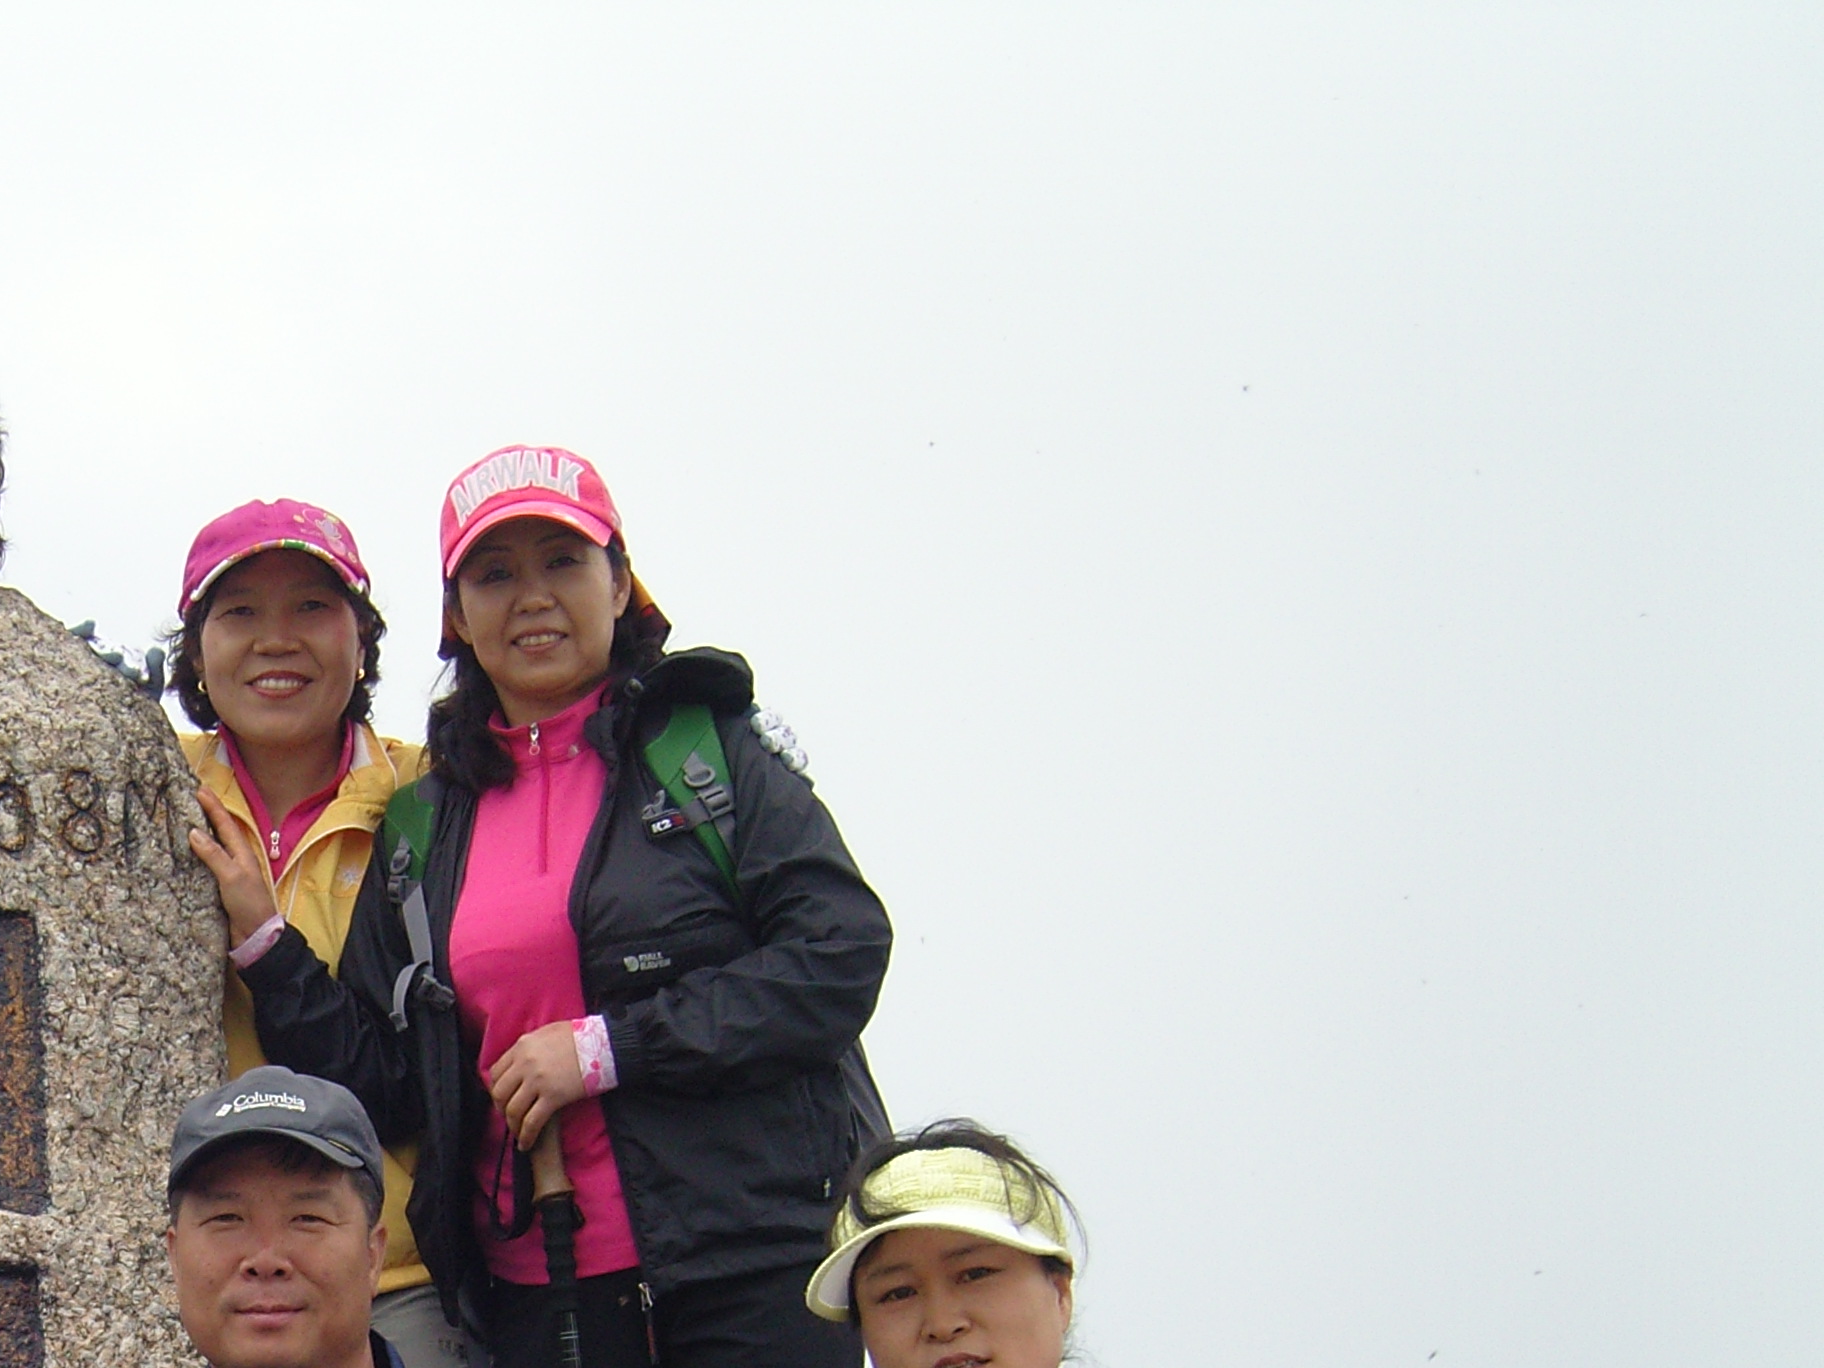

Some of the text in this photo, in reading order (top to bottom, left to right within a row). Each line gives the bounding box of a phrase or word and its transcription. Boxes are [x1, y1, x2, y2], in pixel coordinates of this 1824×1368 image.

[450, 450, 585, 528] AIRWALK
[651, 818, 673, 833] K2
[233, 1091, 306, 1107] Columbia
